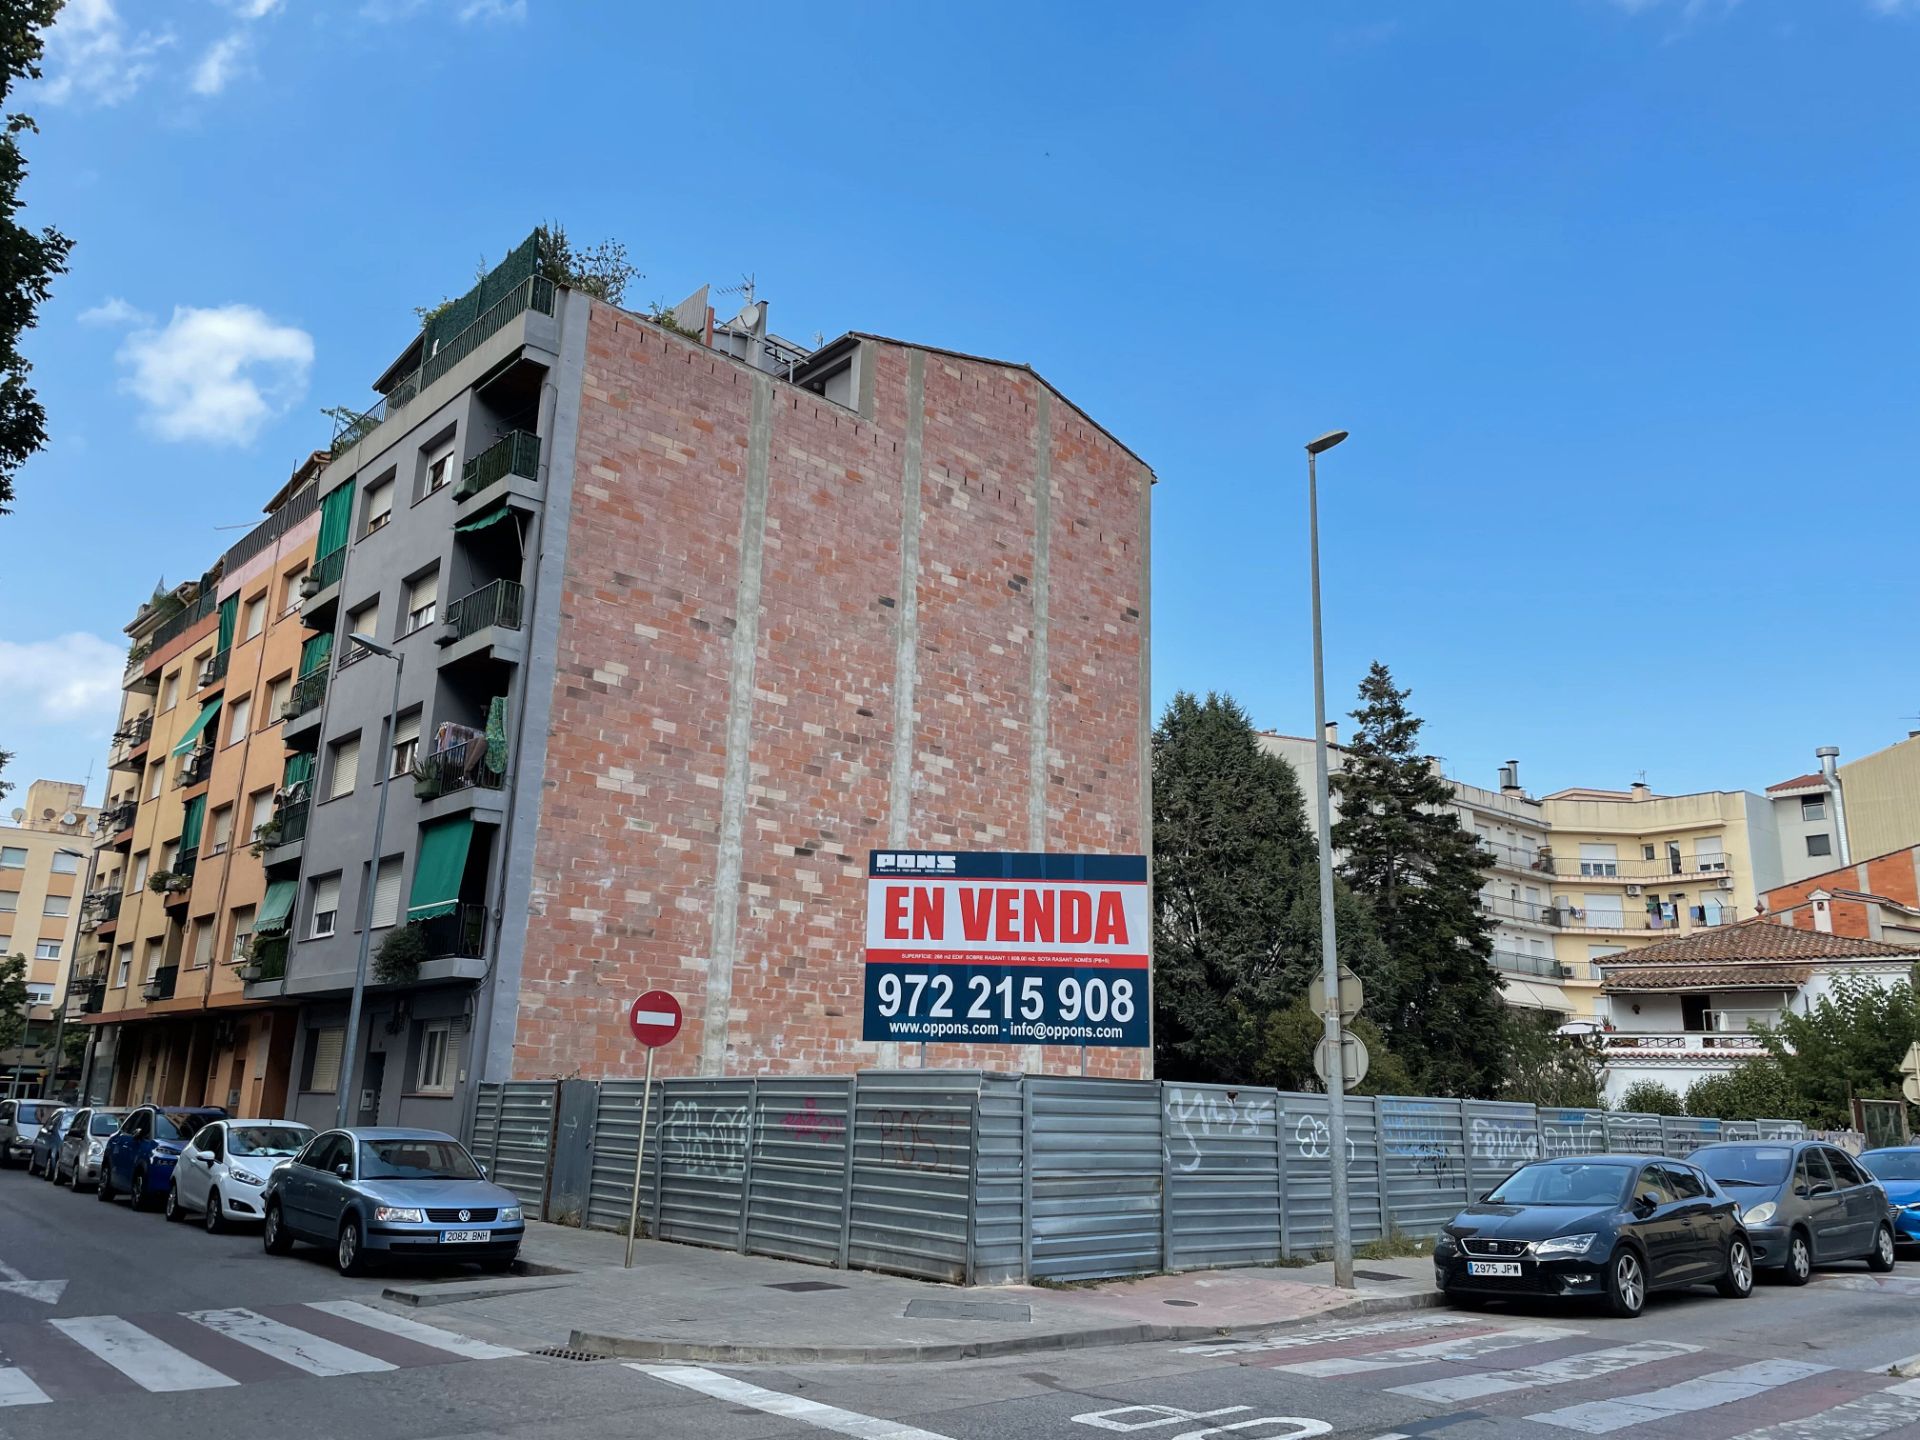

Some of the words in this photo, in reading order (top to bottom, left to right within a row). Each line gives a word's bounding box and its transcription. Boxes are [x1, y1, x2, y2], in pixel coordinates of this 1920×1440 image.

[876, 854, 956, 869] PONS
[885, 886, 945, 941] EN
[958, 888, 1129, 945] VENDA
[878, 973, 954, 1018] 972
[967, 975, 1044, 1020] 215
[1058, 977, 1135, 1022] 908
[889, 1022, 999, 1037] www.oppons.com
[1010, 1021, 1123, 1040] info@oppons.com
[446, 1231, 468, 1241] 2082
[472, 1231, 488, 1240] BNH
[1474, 1263, 1498, 1274] 2975
[1501, 1264, 1519, 1274] JPW
